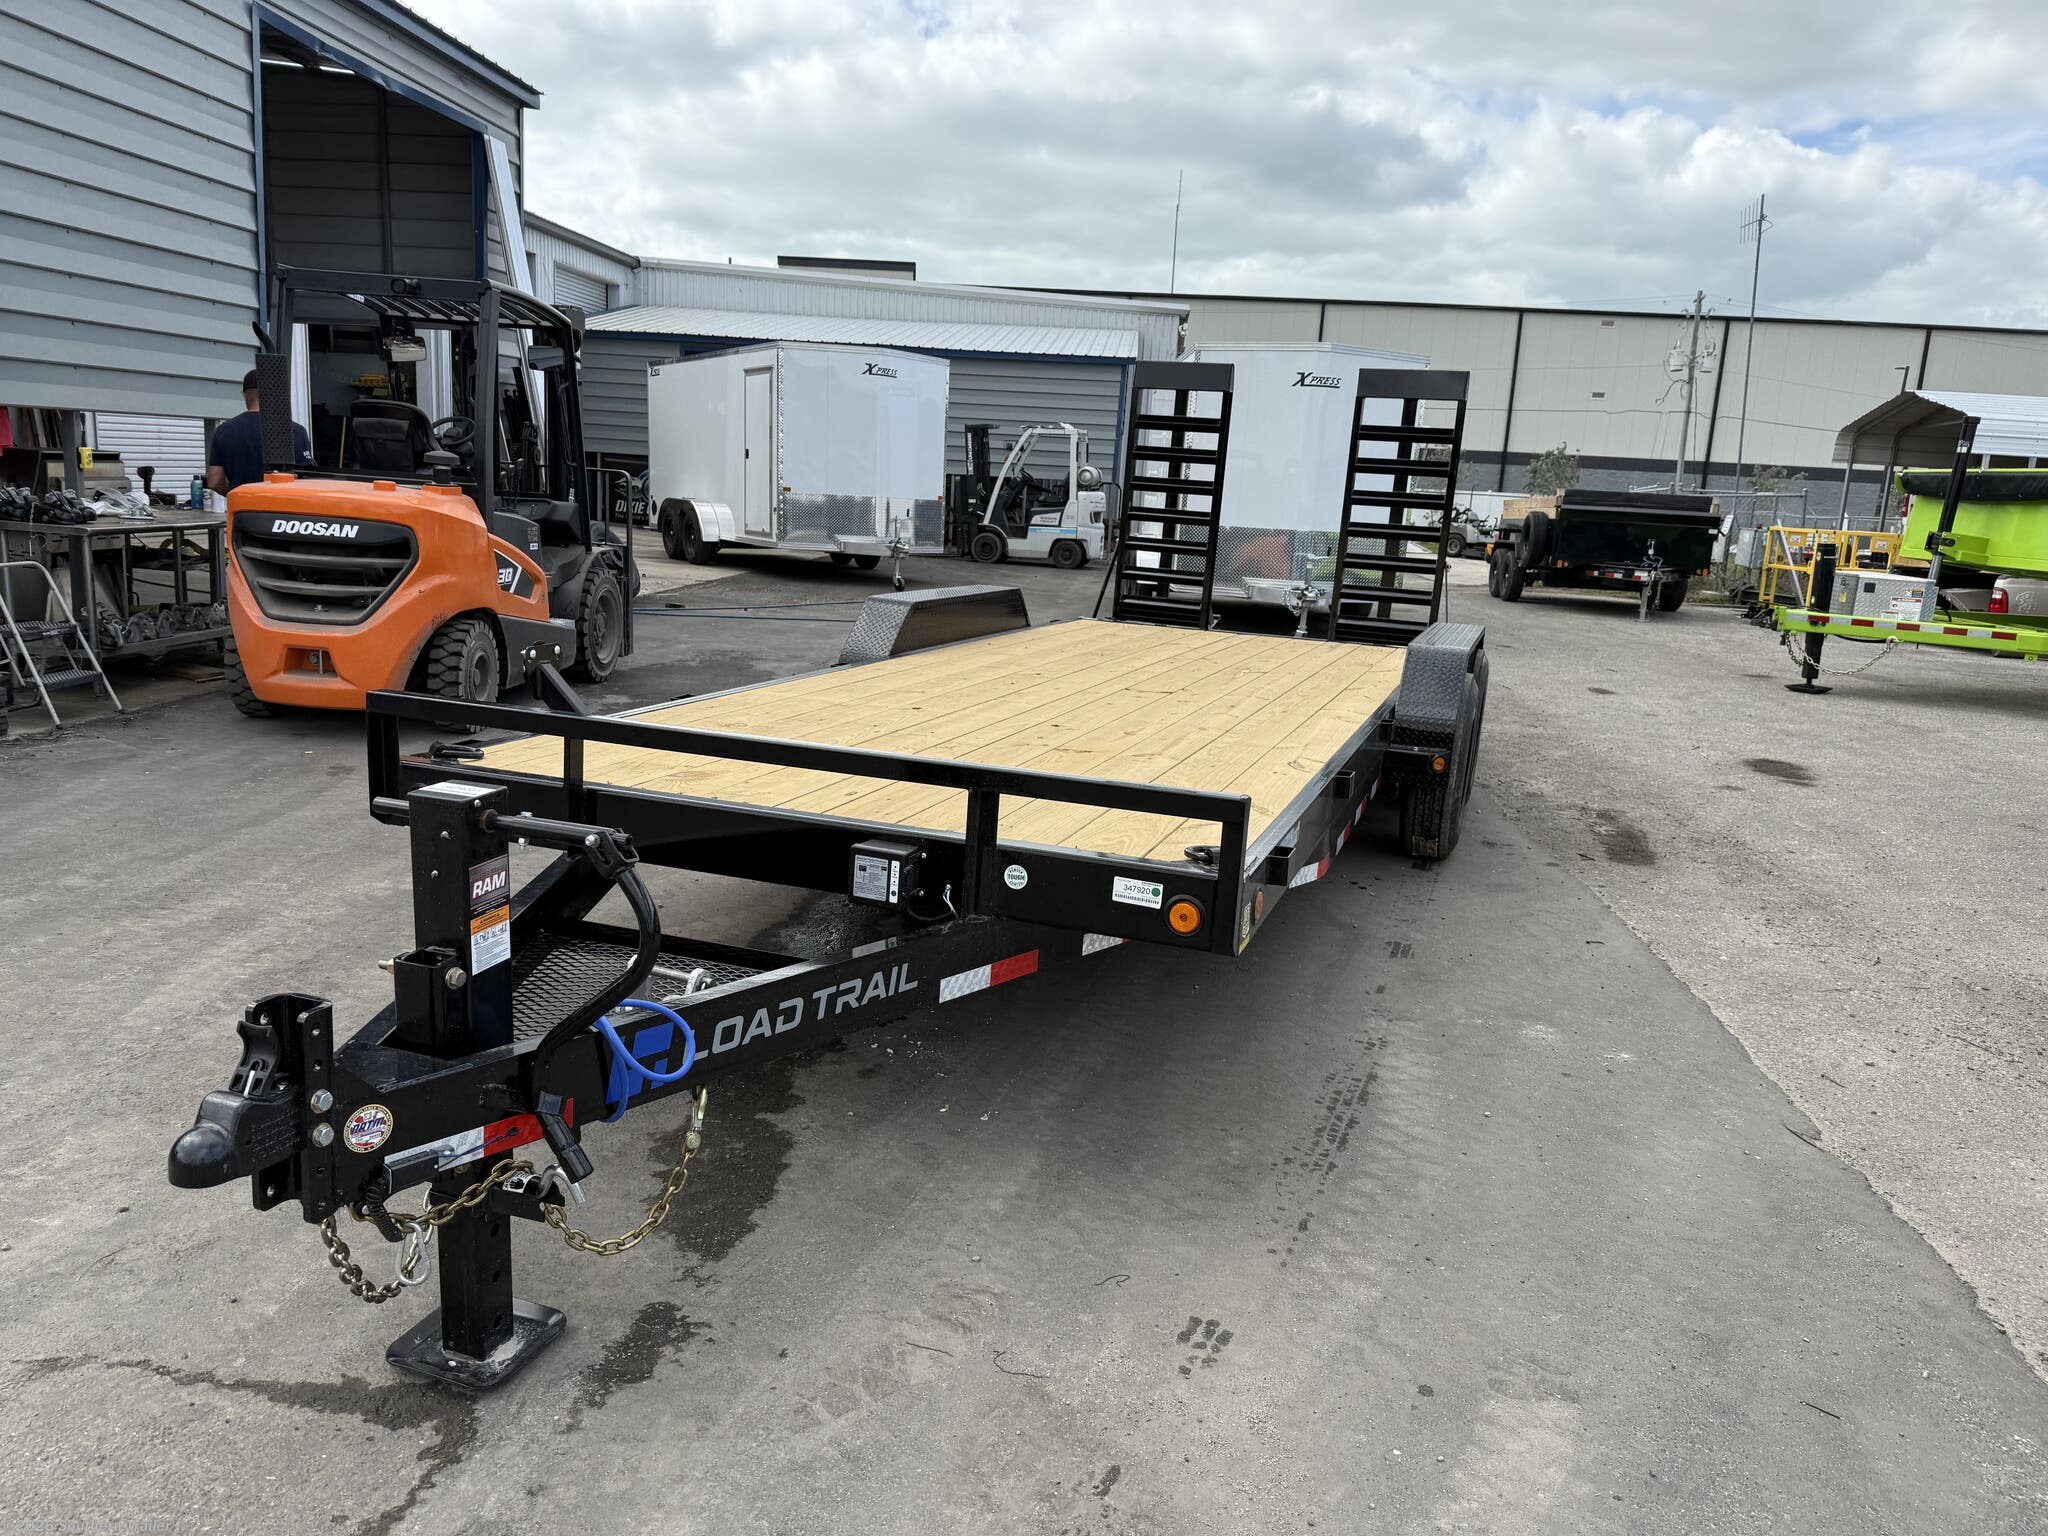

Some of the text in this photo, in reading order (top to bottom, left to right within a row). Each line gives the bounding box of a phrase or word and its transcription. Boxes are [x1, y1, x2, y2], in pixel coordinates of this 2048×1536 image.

[1291, 371, 1342, 388] XPRESS
[272, 519, 359, 538] DOOSAN
[472, 870, 506, 899] RAM
[1123, 883, 1151, 895] 347920
[683, 962, 919, 1065] LOAD TRAIL
